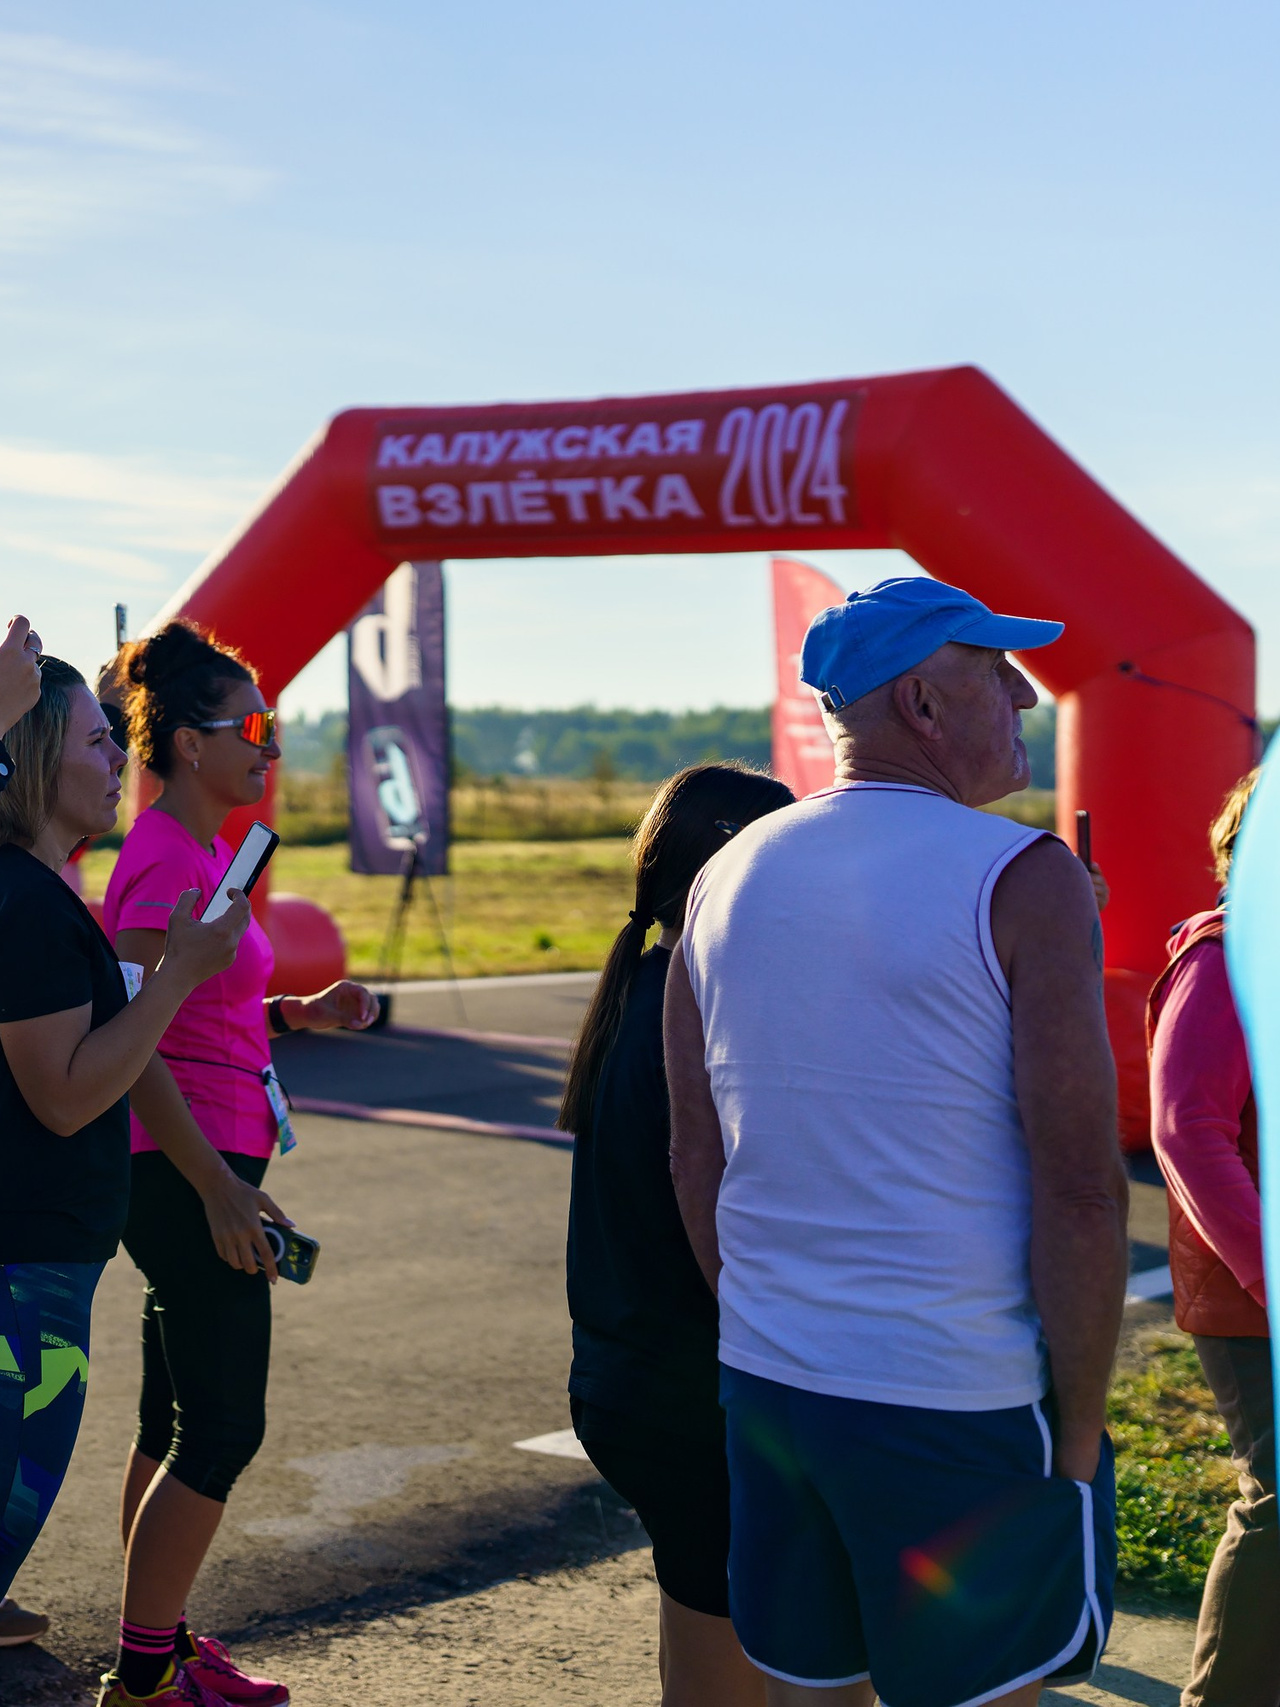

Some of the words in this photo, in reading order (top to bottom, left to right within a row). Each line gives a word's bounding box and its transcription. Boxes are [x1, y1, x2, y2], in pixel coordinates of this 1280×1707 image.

[377, 420, 705, 468] КАЛУЖСКАЯ
[717, 399, 848, 527] 2024
[377, 472, 705, 527] ВЗЛЁТКА
